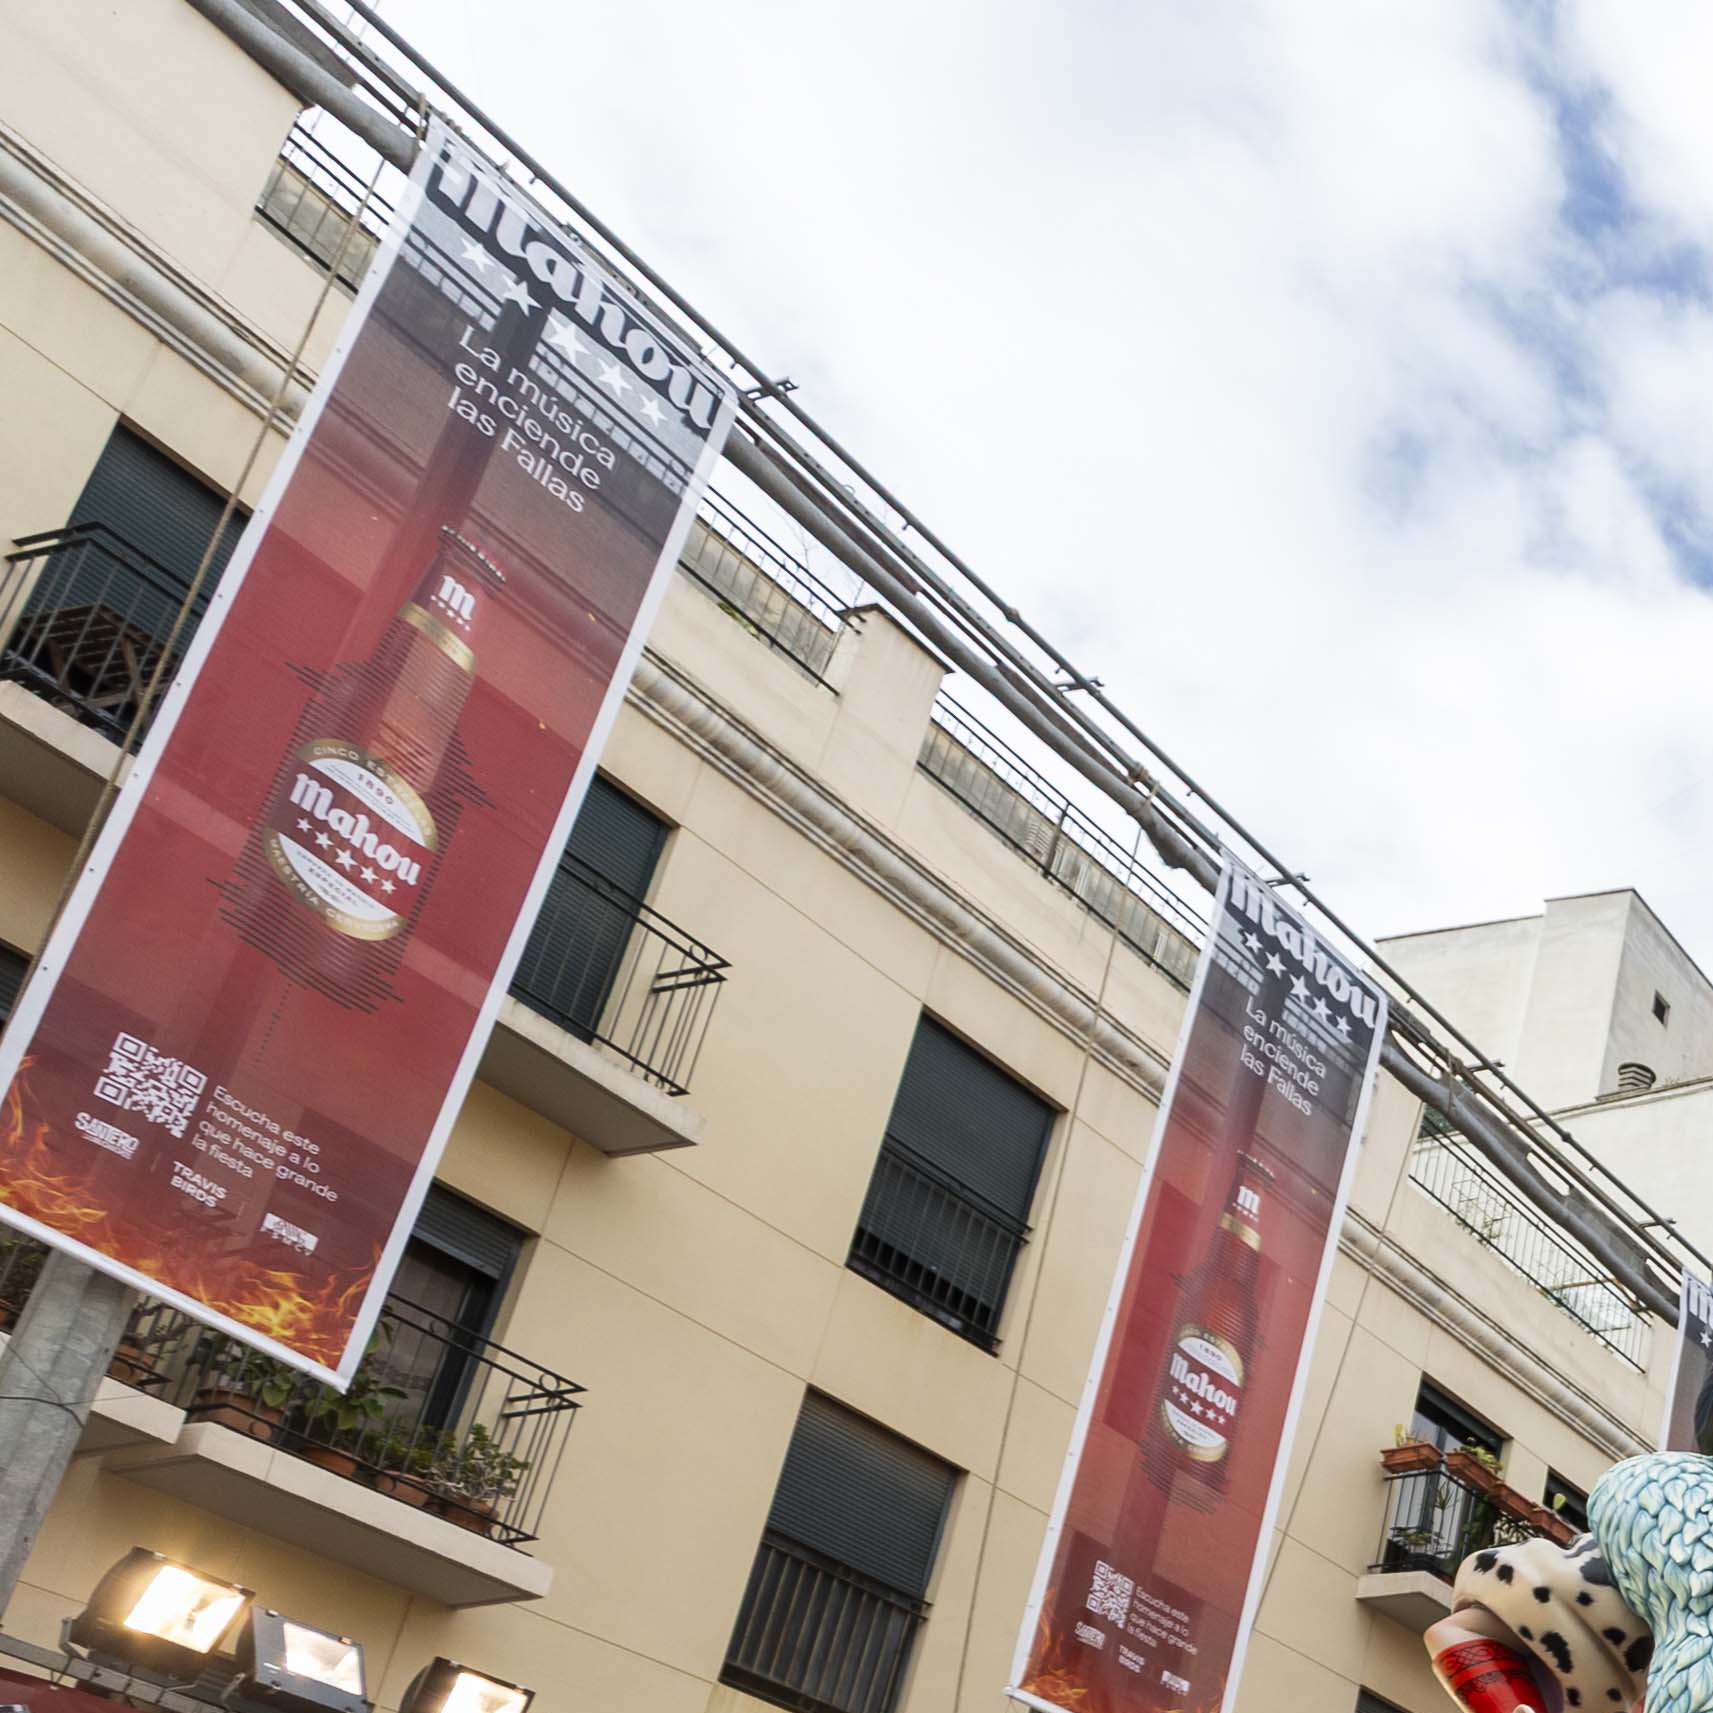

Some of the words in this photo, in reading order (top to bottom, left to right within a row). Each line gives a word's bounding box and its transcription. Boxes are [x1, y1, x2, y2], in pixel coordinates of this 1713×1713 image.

[455, 362, 601, 491] enciende
[459, 325, 501, 371] La
[507, 367, 617, 471] música
[448, 385, 497, 438] las
[501, 430, 585, 513] Fallas
[289, 773, 421, 886] Mahou
[1243, 1024, 1320, 1097] enciende
[1245, 994, 1267, 1026] La
[1269, 1016, 1327, 1080] música
[1240, 1042, 1264, 1074] las
[1267, 1068, 1312, 1117] Fallas
[75, 1112, 140, 1152] SANTERO
[192, 1133, 206, 1151] la
[209, 1144, 253, 1178] fiesta
[206, 1102, 287, 1158] homenaje
[289, 1153, 300, 1165] a
[303, 1157, 320, 1174] lo
[212, 1085, 281, 1134] Escucha
[282, 1128, 321, 1155] este
[170, 1175, 217, 1208] BIRDS
[173, 1161, 228, 1199] TRAVIS
[199, 1120, 231, 1145] que
[232, 1136, 275, 1169] hace
[275, 1165, 338, 1202] grande
[1170, 1352, 1237, 1417] Mahou
